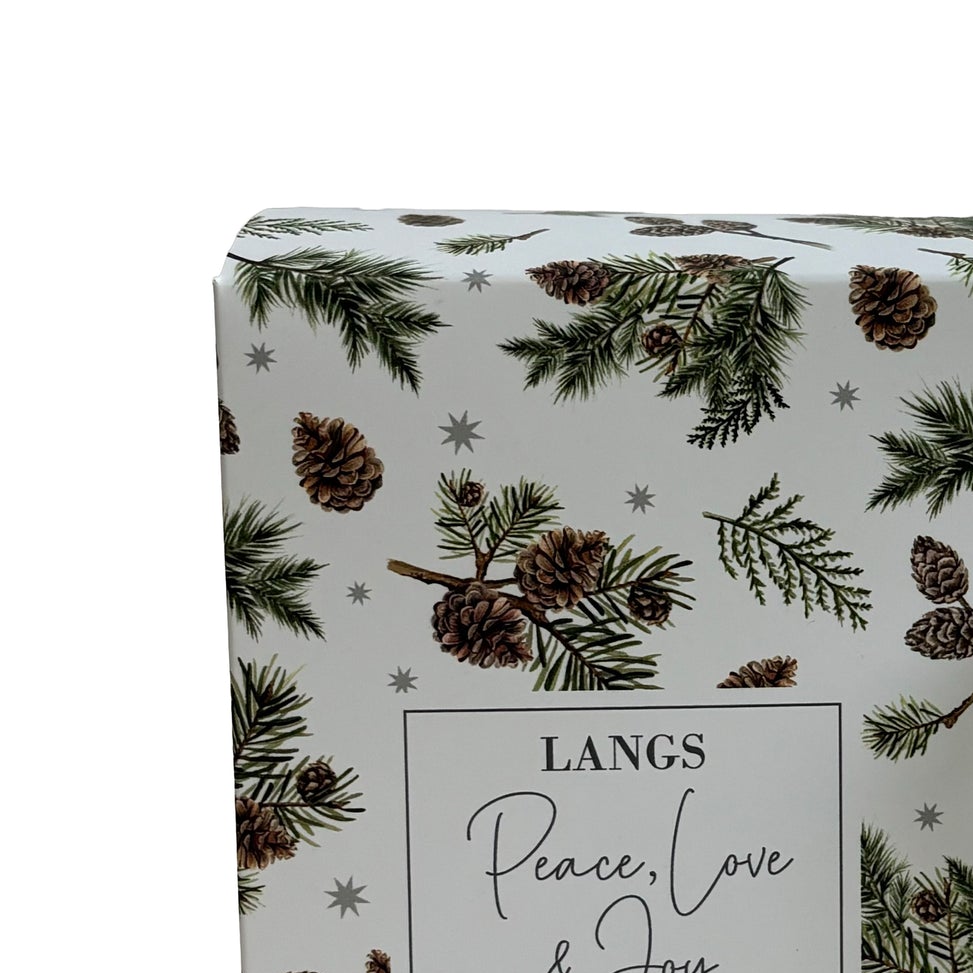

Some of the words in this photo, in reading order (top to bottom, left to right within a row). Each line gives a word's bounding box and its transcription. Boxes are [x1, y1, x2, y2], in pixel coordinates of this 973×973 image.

[539, 732, 706, 772] LANGS
[466, 791, 658, 921] Peace,
[669, 787, 795, 917] Love
